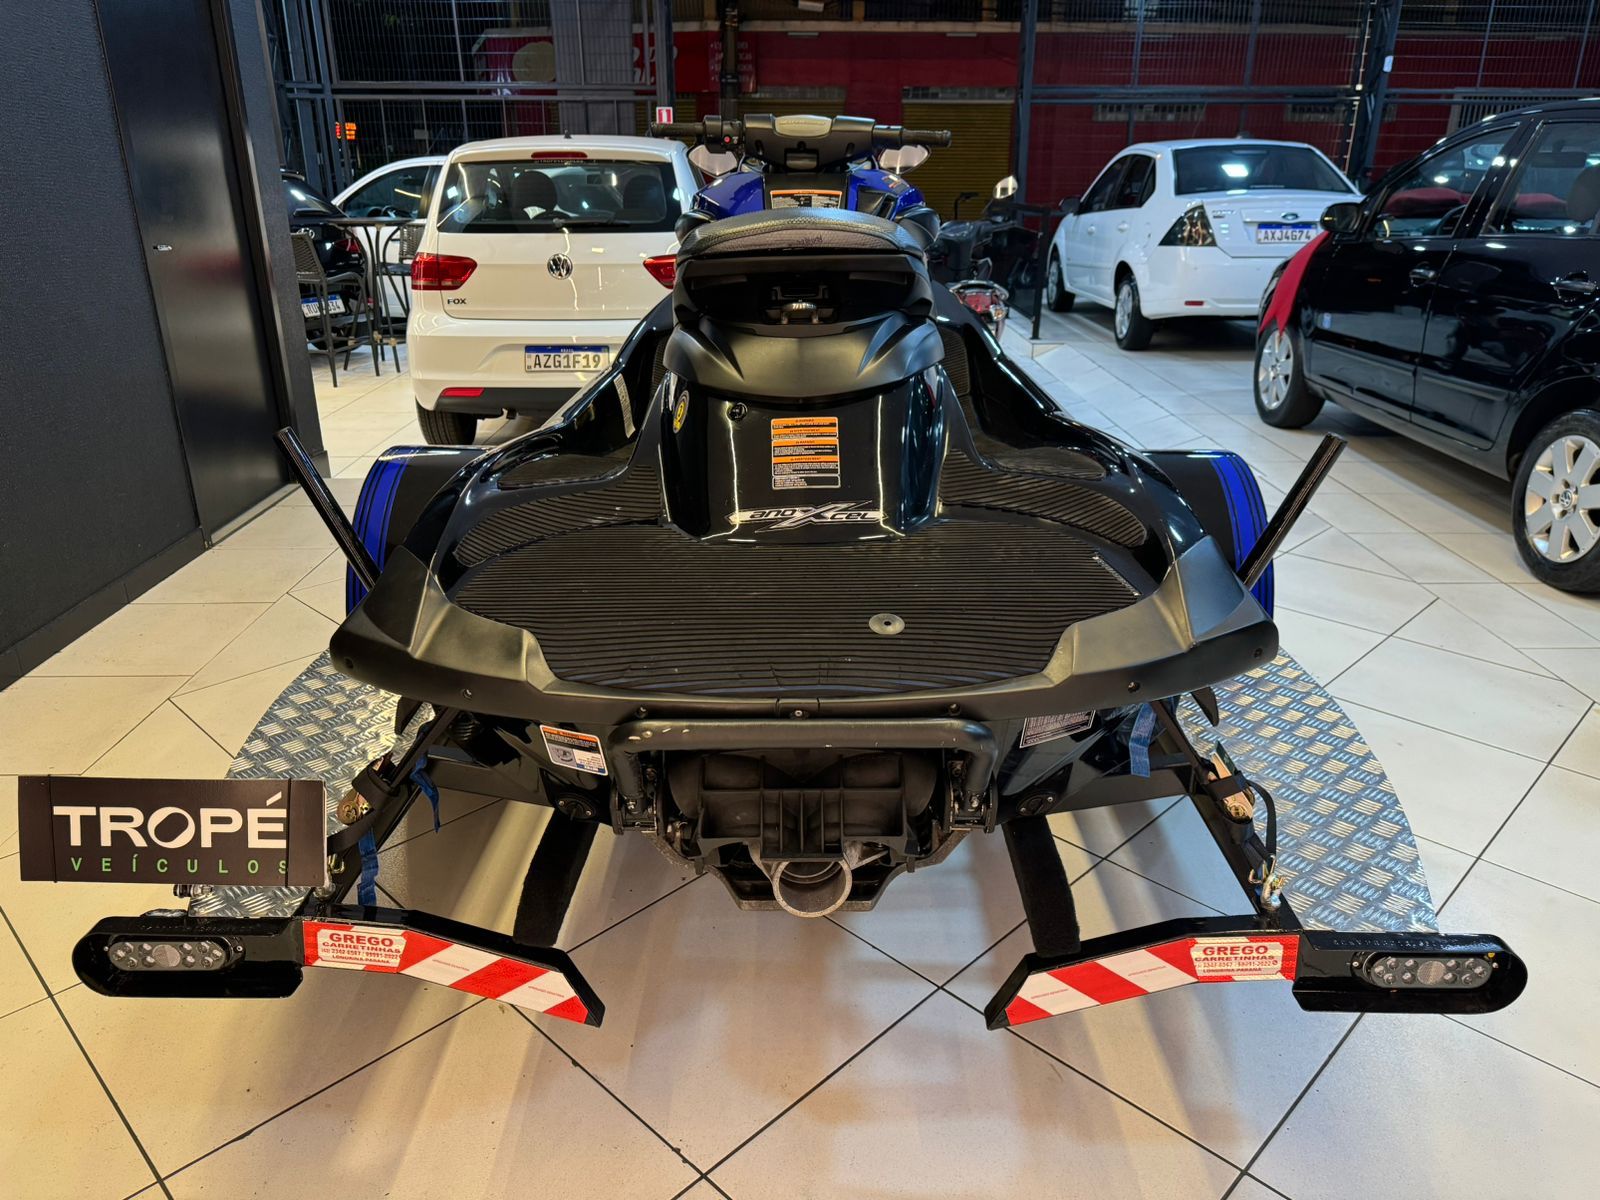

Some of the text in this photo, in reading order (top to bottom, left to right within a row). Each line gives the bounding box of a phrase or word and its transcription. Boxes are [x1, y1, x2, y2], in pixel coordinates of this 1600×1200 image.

[1263, 230, 1312, 241] AXJ4G74
[533, 354, 601, 369] AZG1F19
[53, 791, 287, 849] TROPÉ
[70, 853, 288, 874] VEÍCULOS
[329, 932, 394, 947] GREGO
[322, 941, 401, 954] CARRETINHAS
[1202, 945, 1269, 956] GREGO
